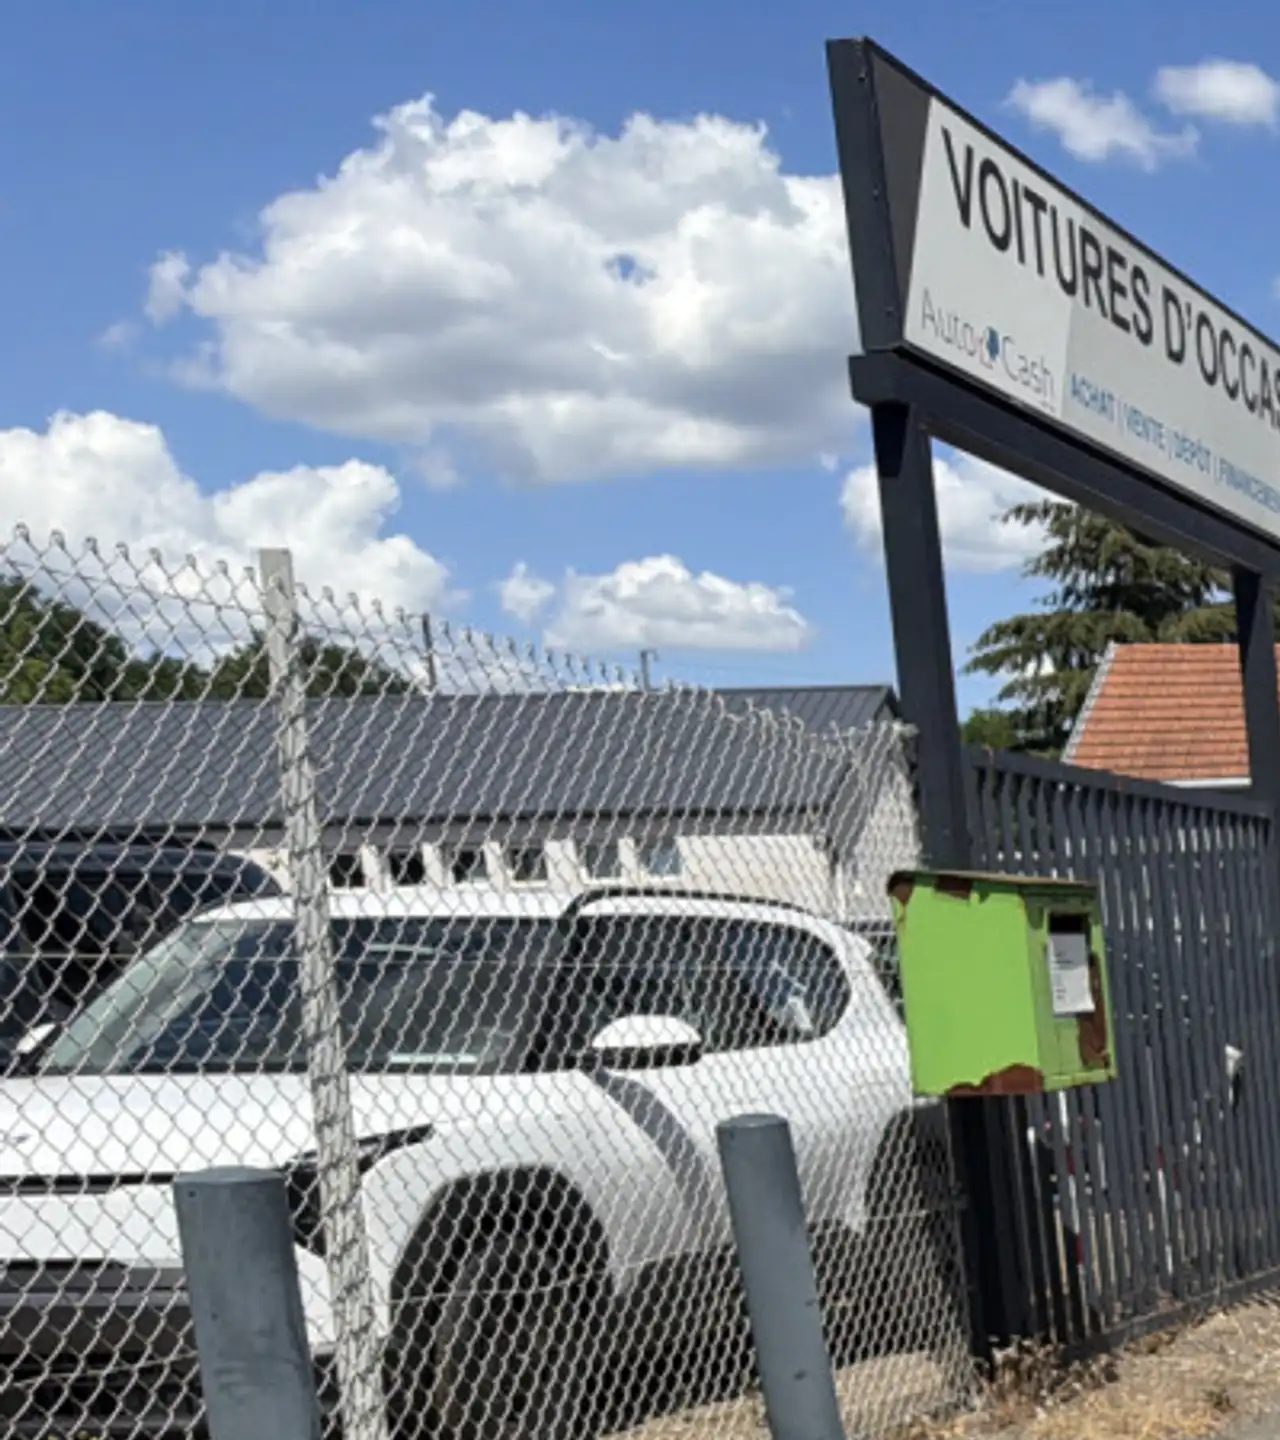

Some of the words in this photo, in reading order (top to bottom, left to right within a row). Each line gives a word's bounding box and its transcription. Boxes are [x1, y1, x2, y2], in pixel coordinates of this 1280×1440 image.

[941, 125, 1154, 347] VOITURES
[1070, 372, 1115, 423] ACHAT
[1122, 402, 1166, 451] VENTE
